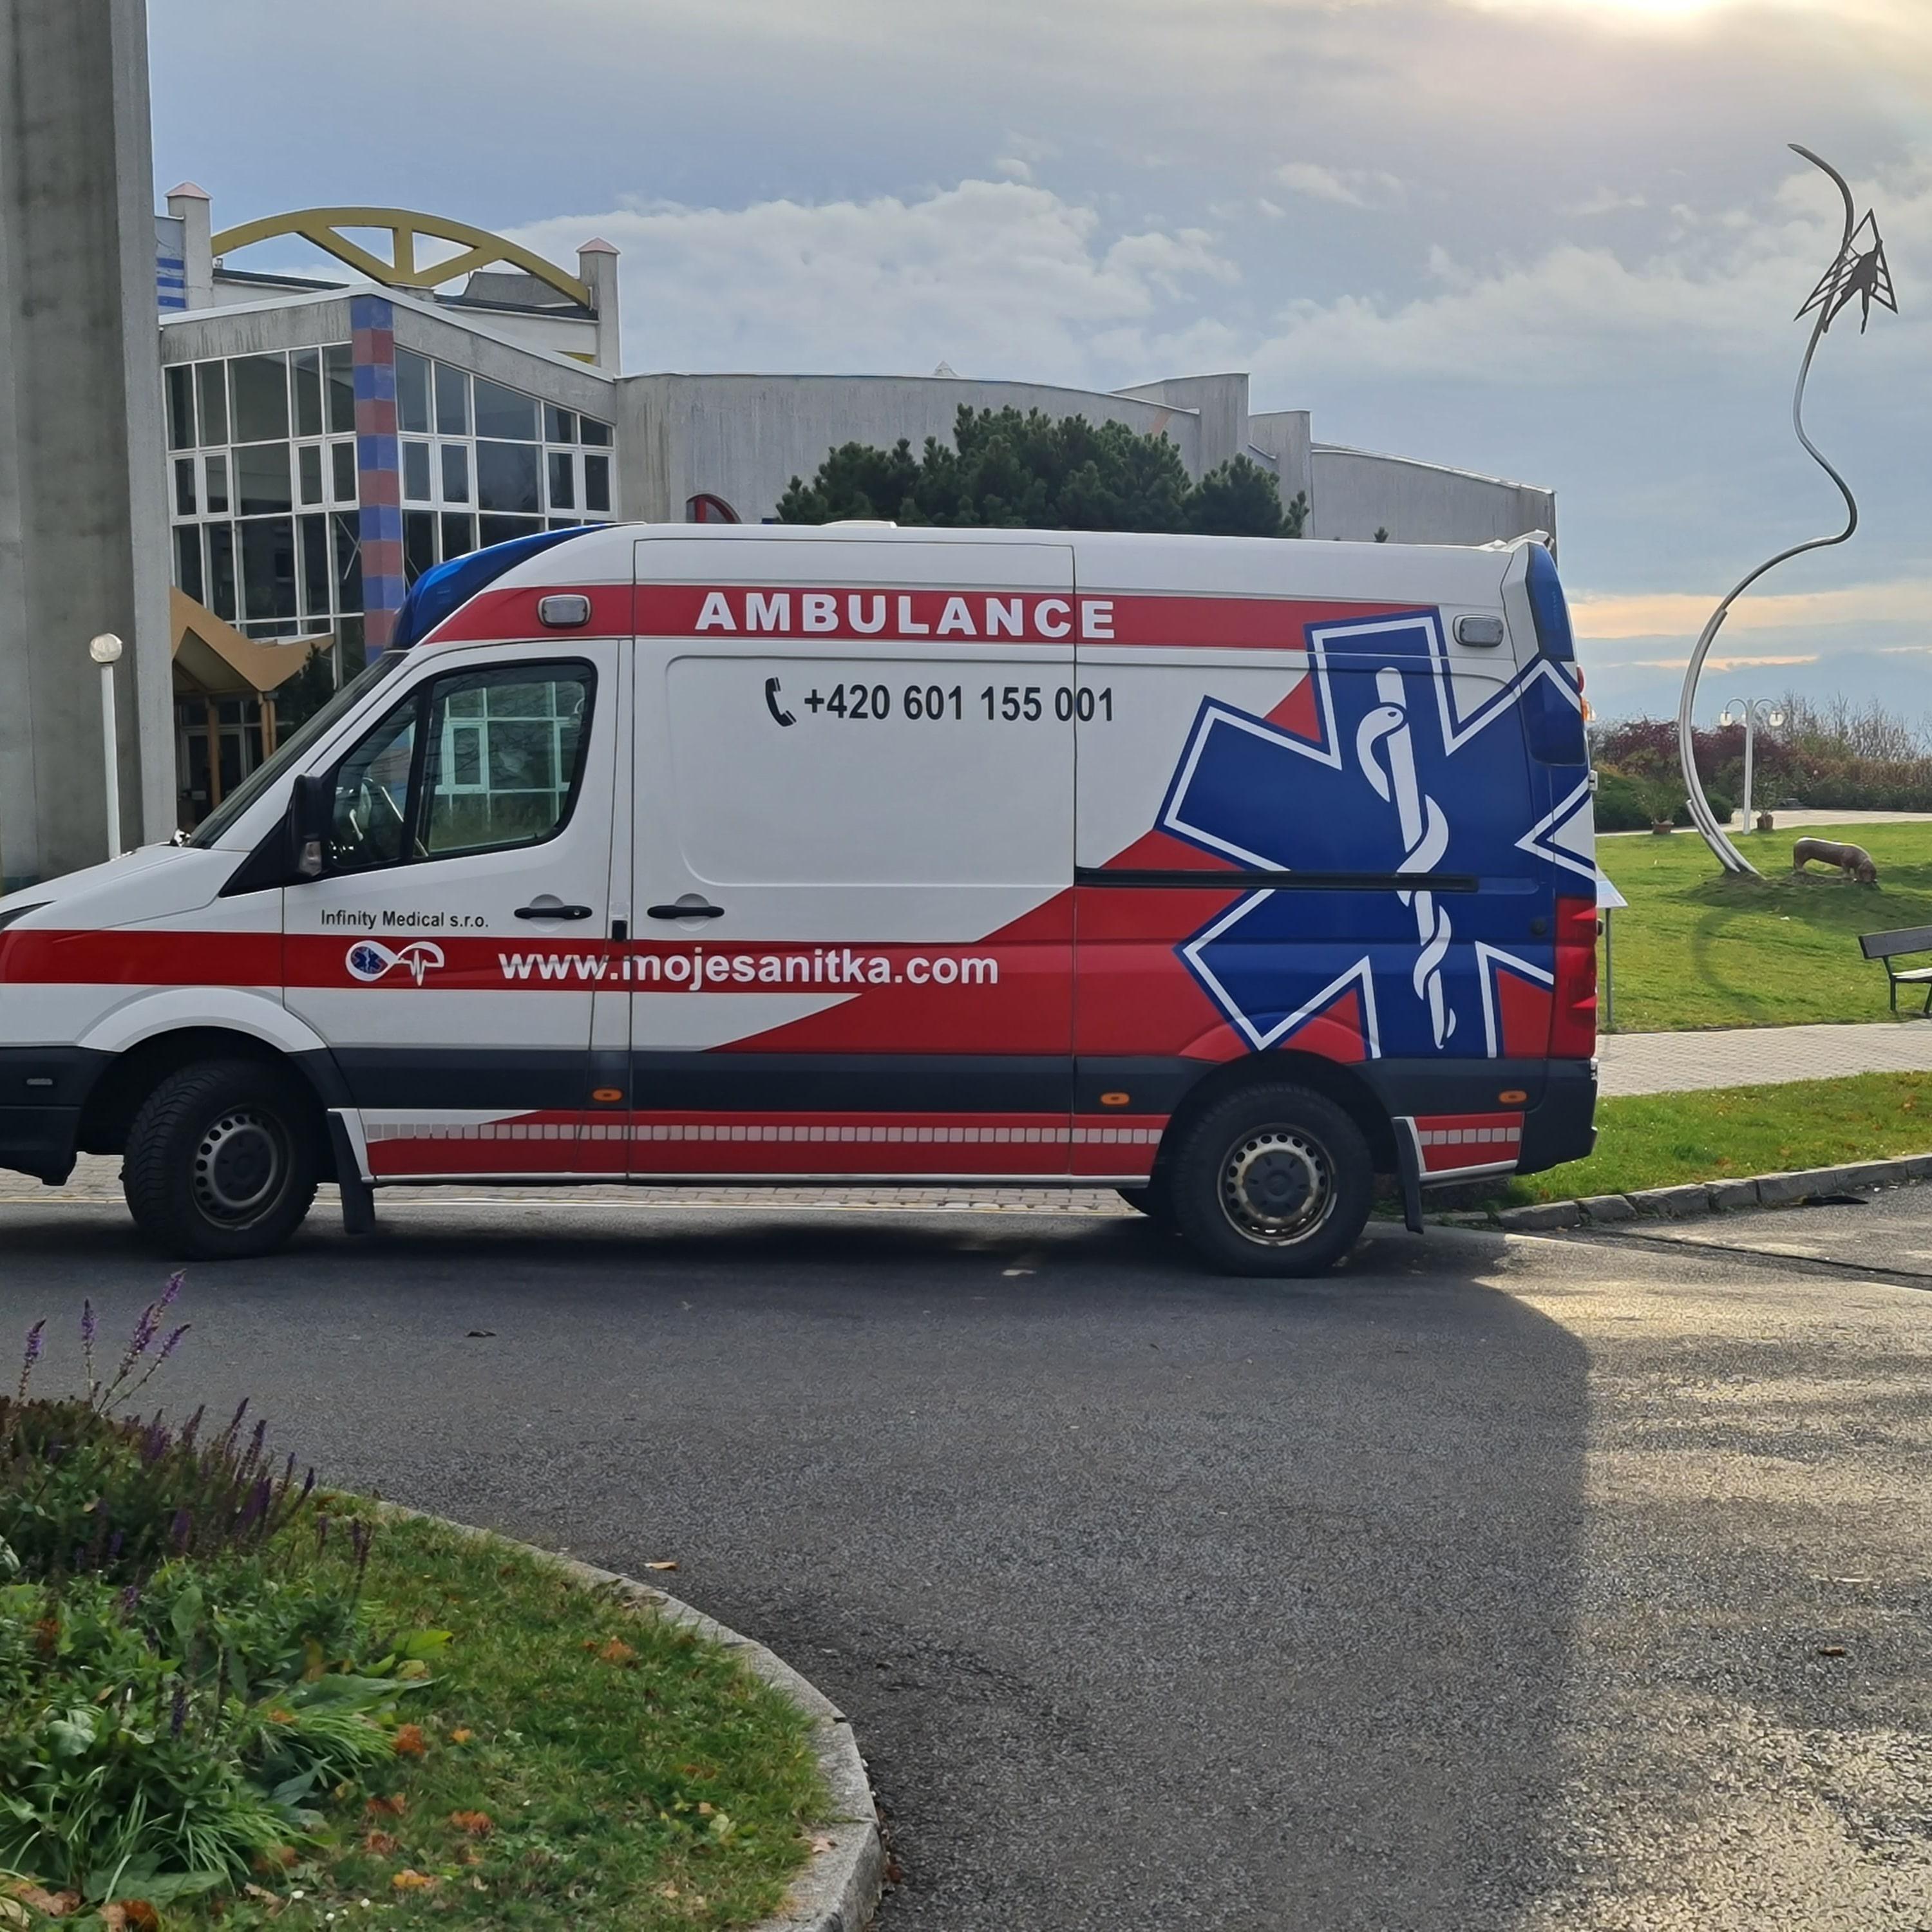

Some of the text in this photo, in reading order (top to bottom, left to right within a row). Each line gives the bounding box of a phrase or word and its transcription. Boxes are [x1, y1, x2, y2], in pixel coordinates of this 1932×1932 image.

[696, 592, 1115, 638] AMBULANCE
[804, 683, 1113, 722] +420 601 155 001
[321, 909, 489, 930] Infinity Medical s.r.o.
[498, 947, 998, 992] www.mojesanitka.com
